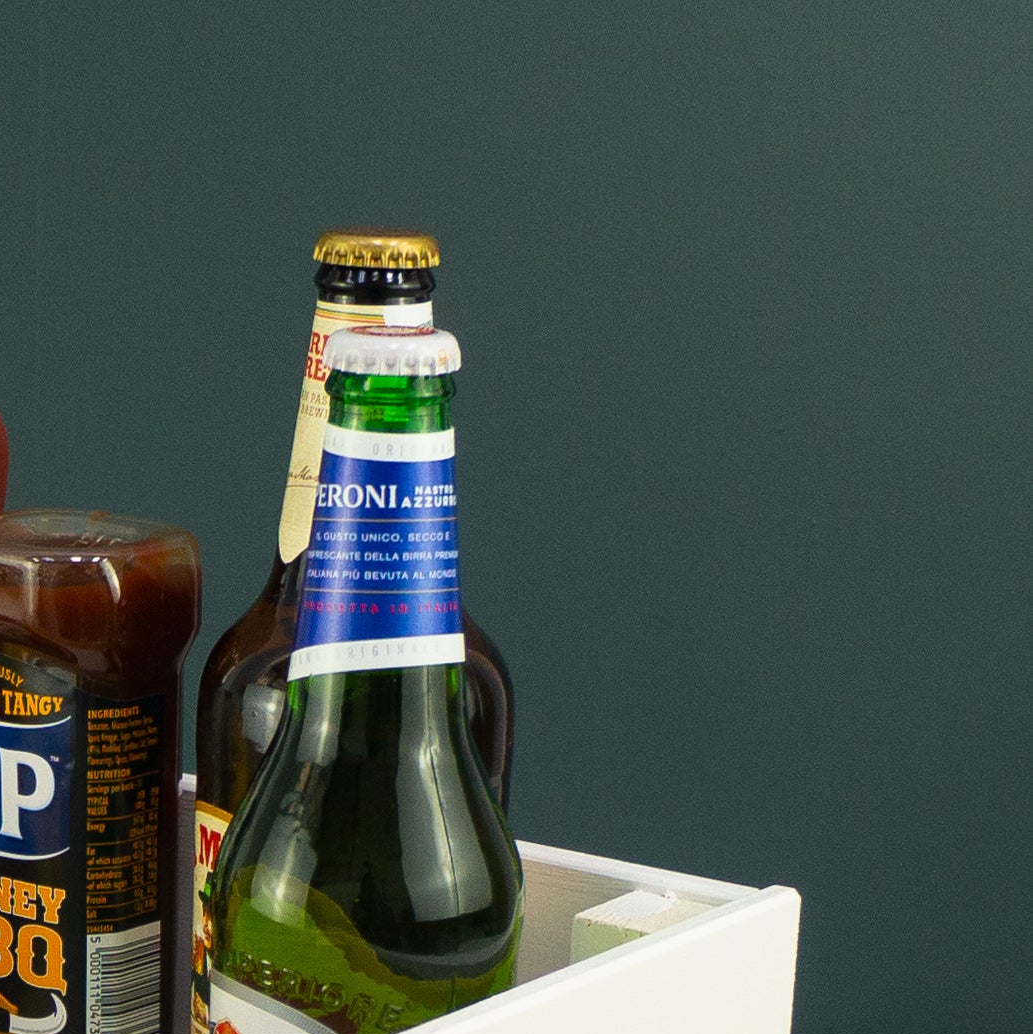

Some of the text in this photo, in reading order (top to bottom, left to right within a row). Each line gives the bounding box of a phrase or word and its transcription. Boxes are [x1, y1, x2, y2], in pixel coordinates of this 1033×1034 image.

[315, 484, 454, 509] ERONI NASTRO
[323, 531, 357, 542] GUSTO
[361, 532, 403, 544] UNICO,
[407, 532, 443, 542] SECCO
[364, 551, 399, 562] DELLA
[402, 551, 433, 562] BIRRA
[342, 569, 360, 580] PIÙ
[364, 570, 408, 581] BEVUTA
[412, 570, 425, 580] AL
[429, 568, 456, 580] MONDO
[2, 689, 63, 717] TANGY
[87, 705, 140, 719] INGREDIENTS
[87, 769, 131, 780] NUTRITION
[86, 822, 106, 832] Energy
[90, 936, 101, 944] 5
[90, 951, 101, 998] 000111
